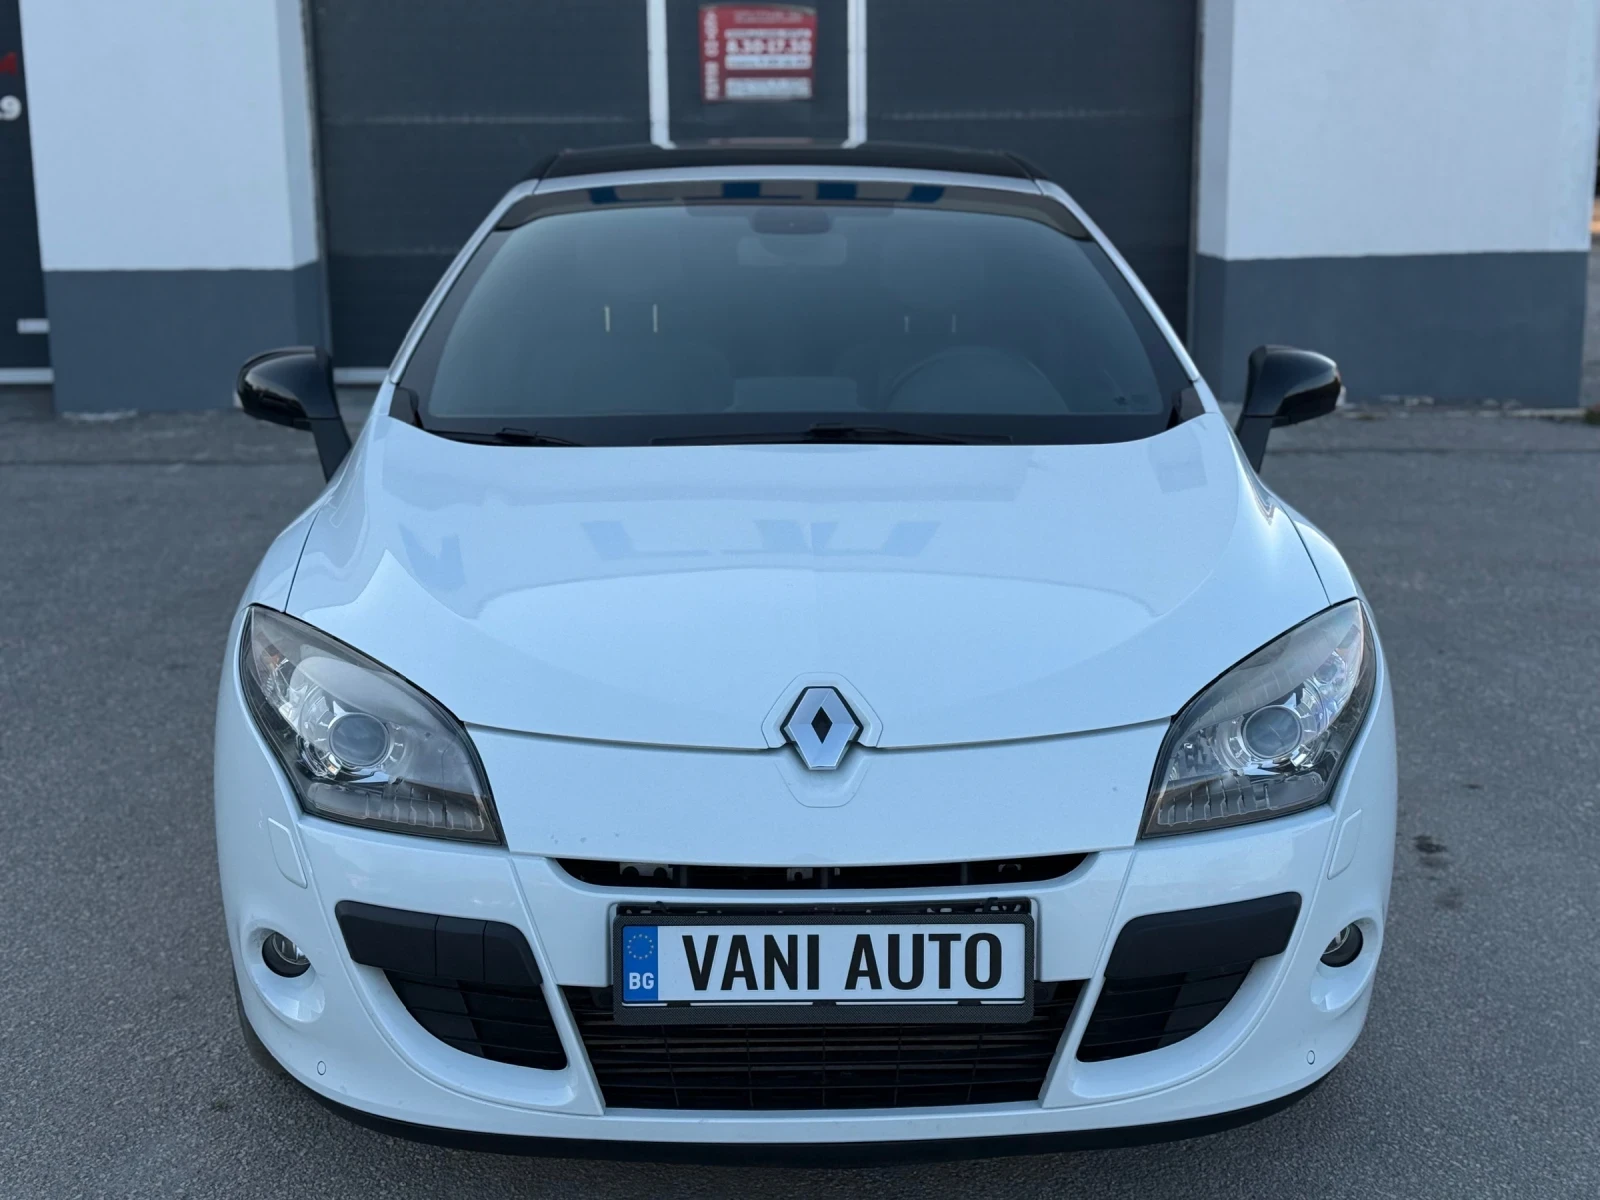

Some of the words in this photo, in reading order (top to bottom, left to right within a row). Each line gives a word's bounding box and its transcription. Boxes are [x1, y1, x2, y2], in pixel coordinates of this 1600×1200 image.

[681, 934, 820, 991] VANI
[844, 932, 1002, 991] AUTO
[628, 972, 655, 990] BG
